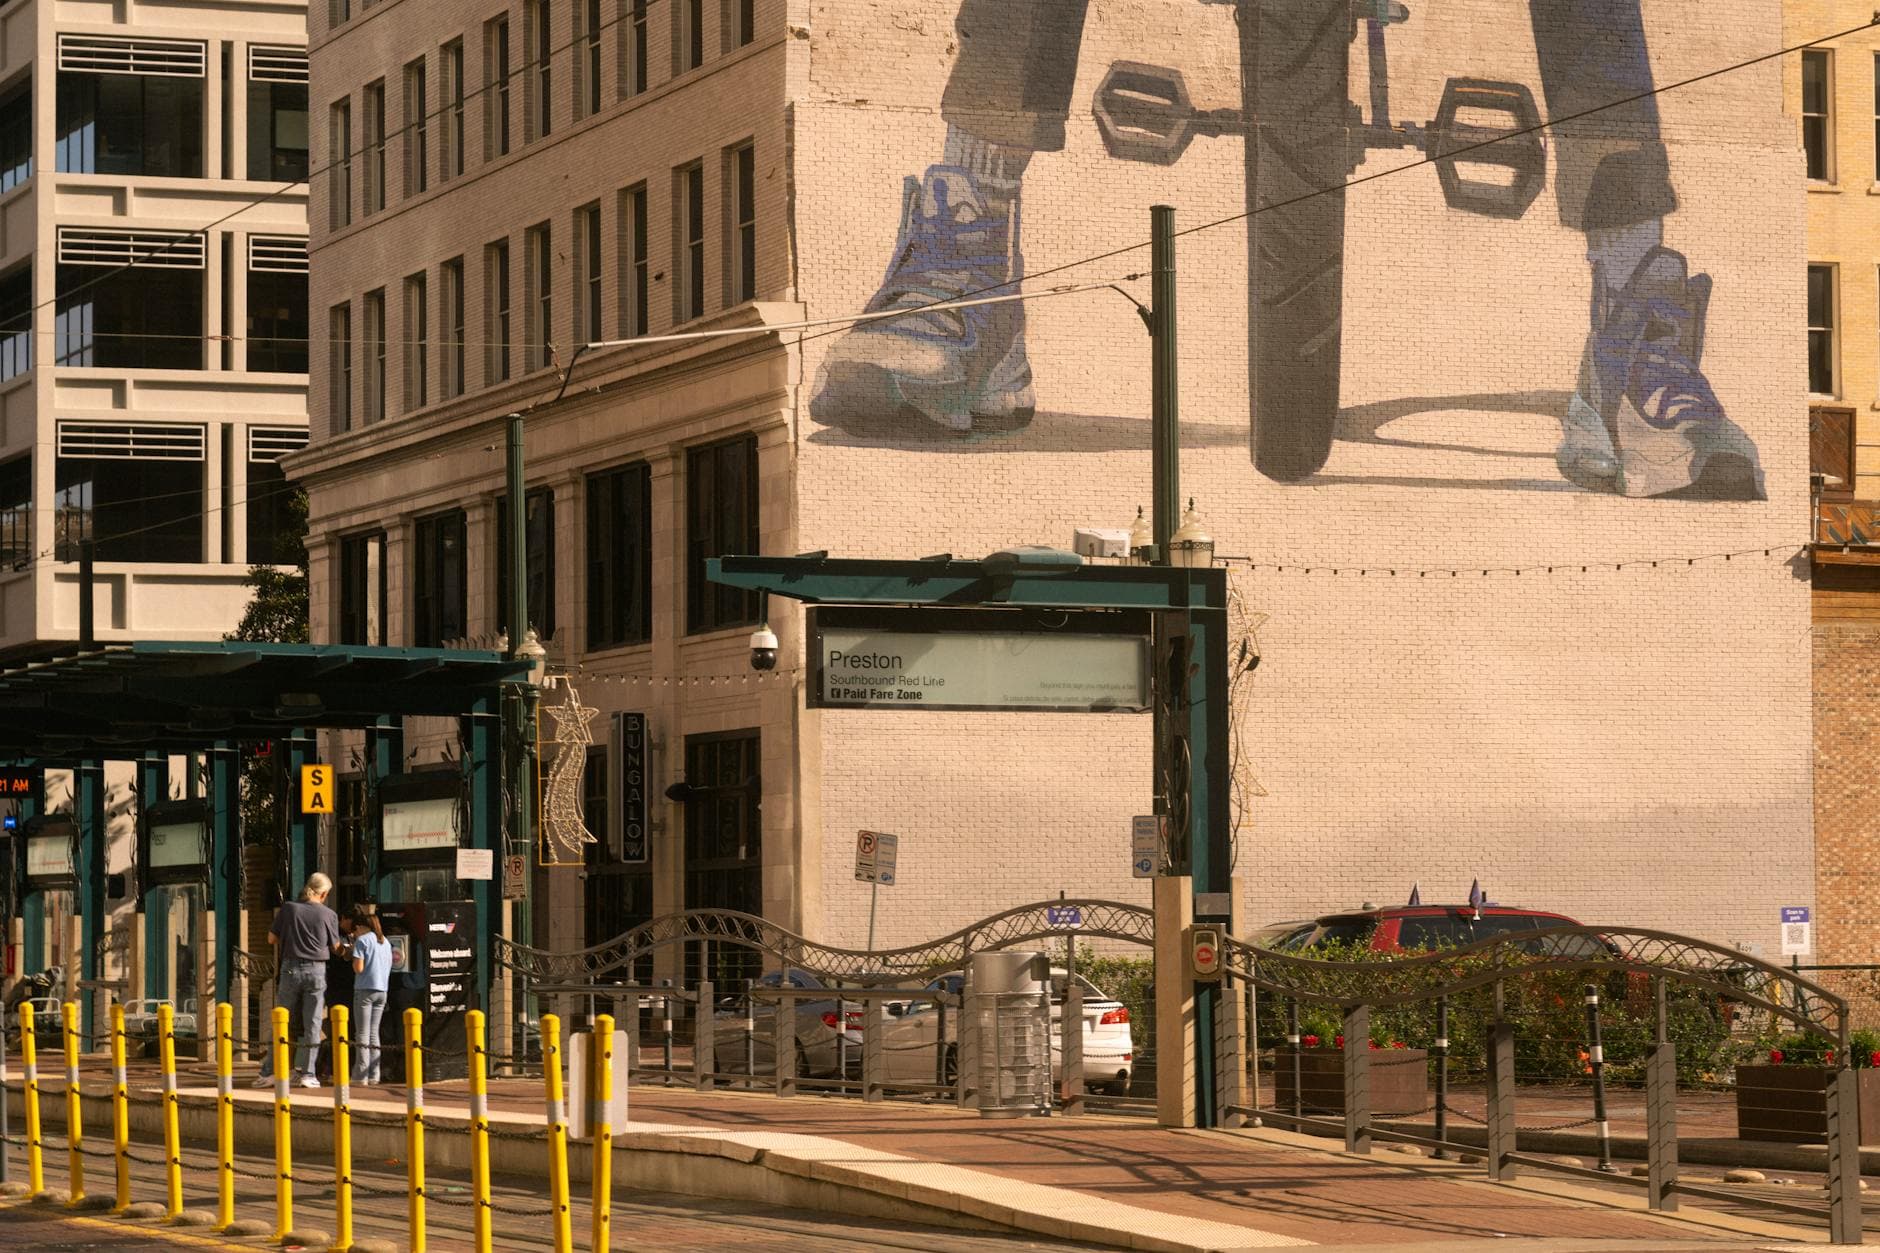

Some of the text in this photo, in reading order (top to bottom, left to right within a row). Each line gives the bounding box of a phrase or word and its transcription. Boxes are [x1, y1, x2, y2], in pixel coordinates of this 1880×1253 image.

[830, 650, 902, 669] Preston
[830, 674, 945, 686] Southbound Red Line
[843, 688, 923, 700] Paid Fare Zone
[12, 778, 29, 792] AM
[311, 769, 324, 786] S
[626, 716, 643, 857] BUNGALOW
[310, 791, 325, 808] A
[429, 948, 454, 959] Welcome
